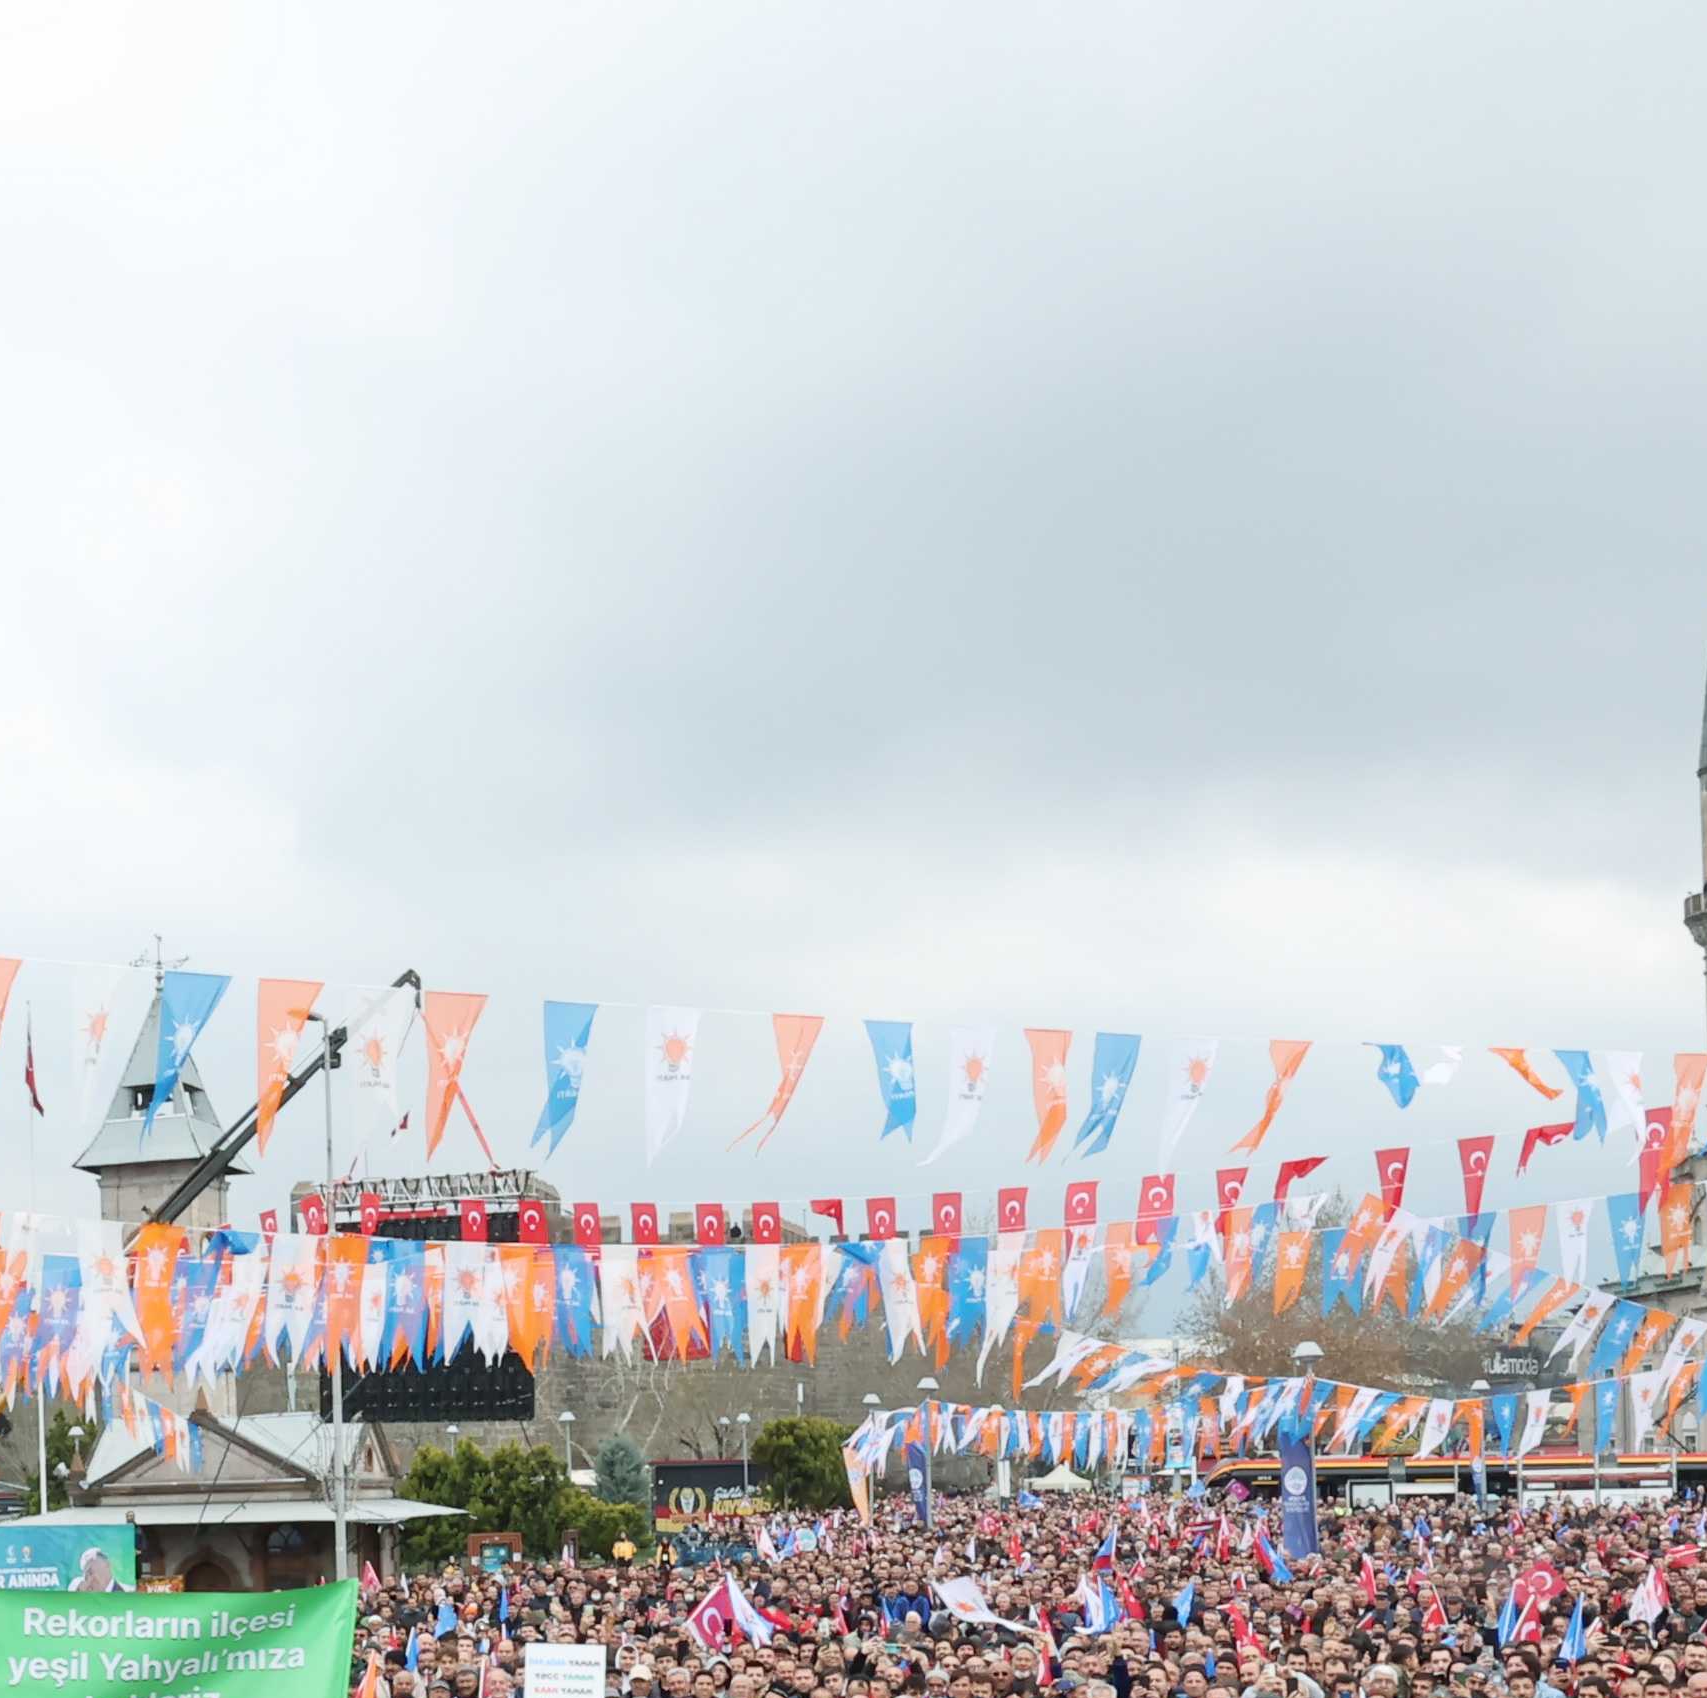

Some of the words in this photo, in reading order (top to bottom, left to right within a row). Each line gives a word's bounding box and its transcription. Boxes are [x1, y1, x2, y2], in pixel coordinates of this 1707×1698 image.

[23, 1606, 201, 1640] Rekorların
[210, 1603, 296, 1640] ilçesi
[7, 1651, 89, 1688] yeşil
[100, 1645, 307, 1686] Yahyalı'mıza
